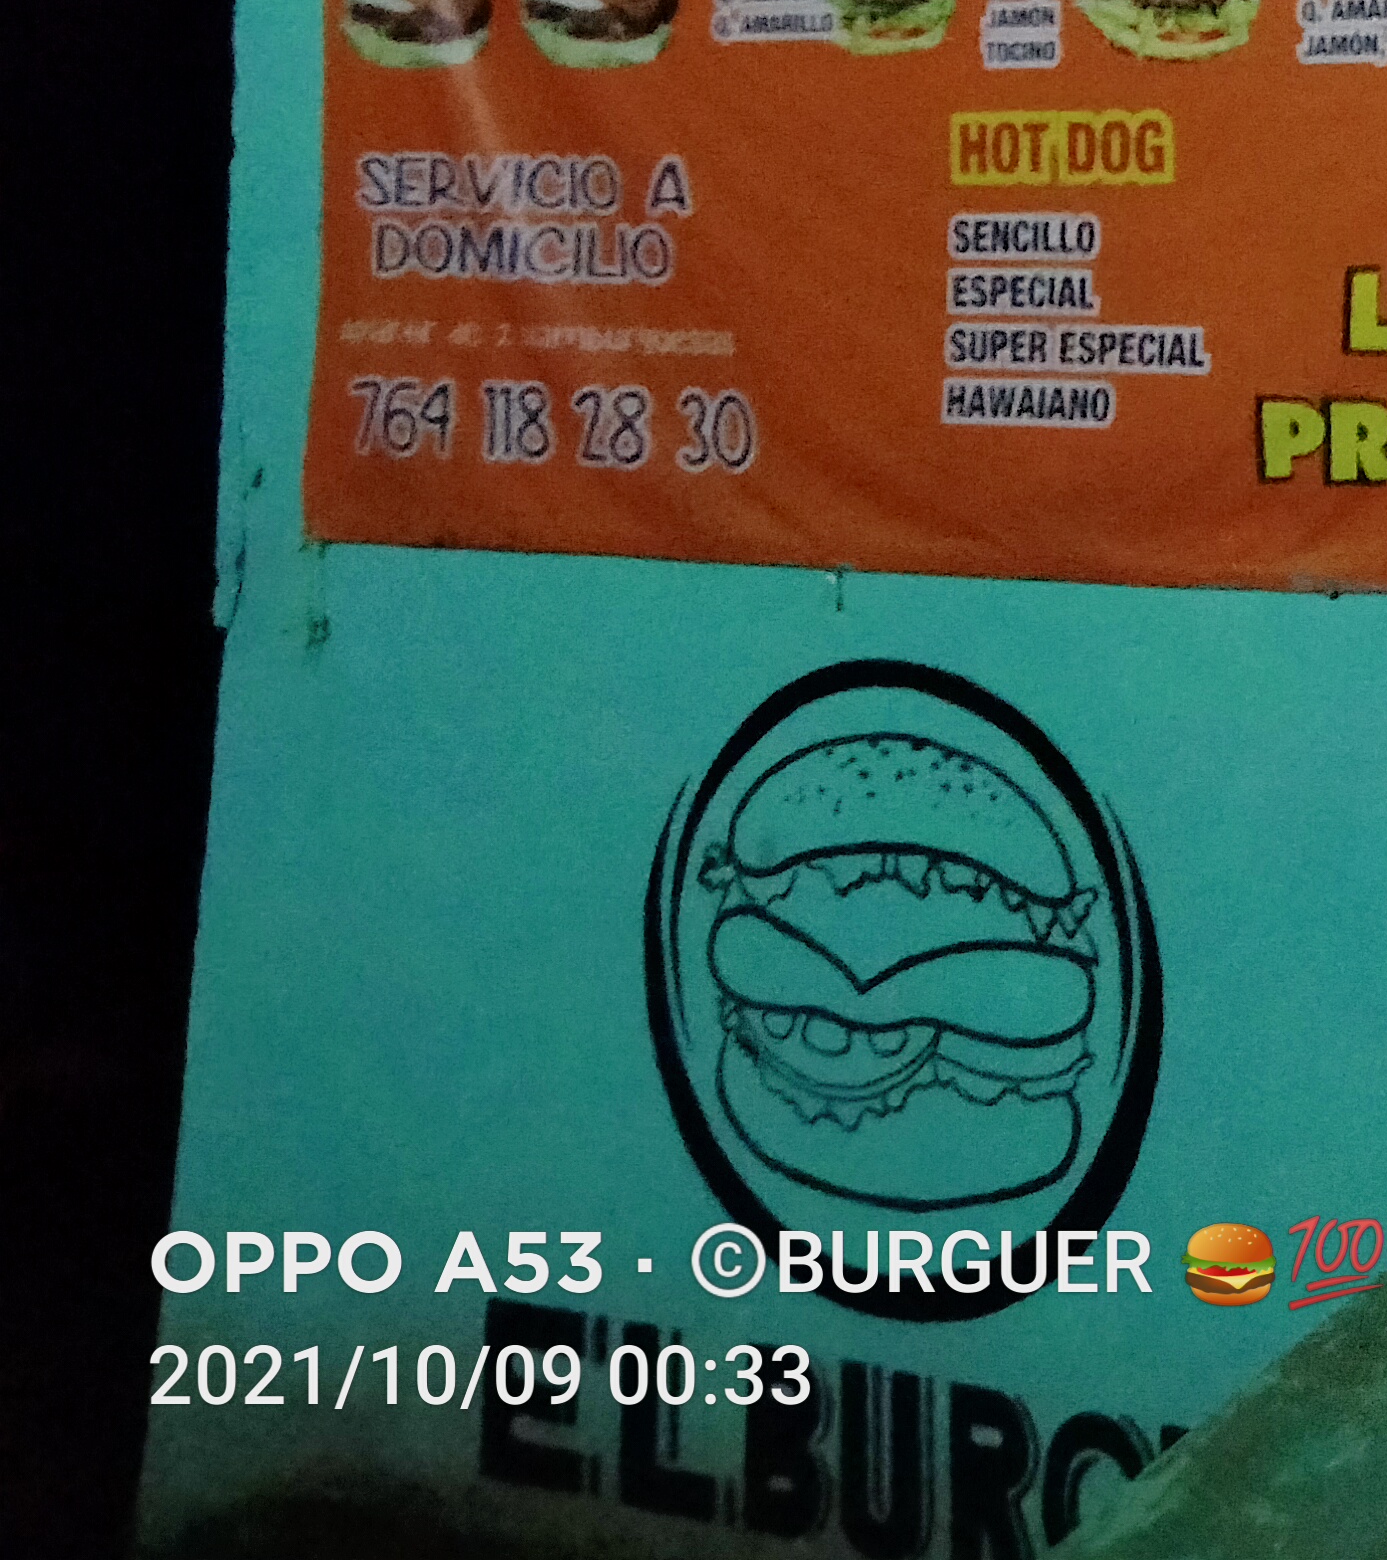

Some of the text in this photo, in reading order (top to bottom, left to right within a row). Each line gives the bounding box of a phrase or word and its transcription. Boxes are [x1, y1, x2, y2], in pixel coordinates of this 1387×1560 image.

[985, 40, 1057, 62] TOCINO
[957, 119, 1167, 175] HOT DOG
[359, 154, 690, 212] SERVICIO A
[374, 222, 673, 279] DOMICILIO
[952, 219, 1097, 254] SENCILLO
[952, 274, 1096, 310] ESPECIAL
[950, 328, 1206, 368] SUPER ESPECIAL
[351, 379, 754, 468] 764 118 28 30
[945, 384, 1112, 423] HAWAIANO
